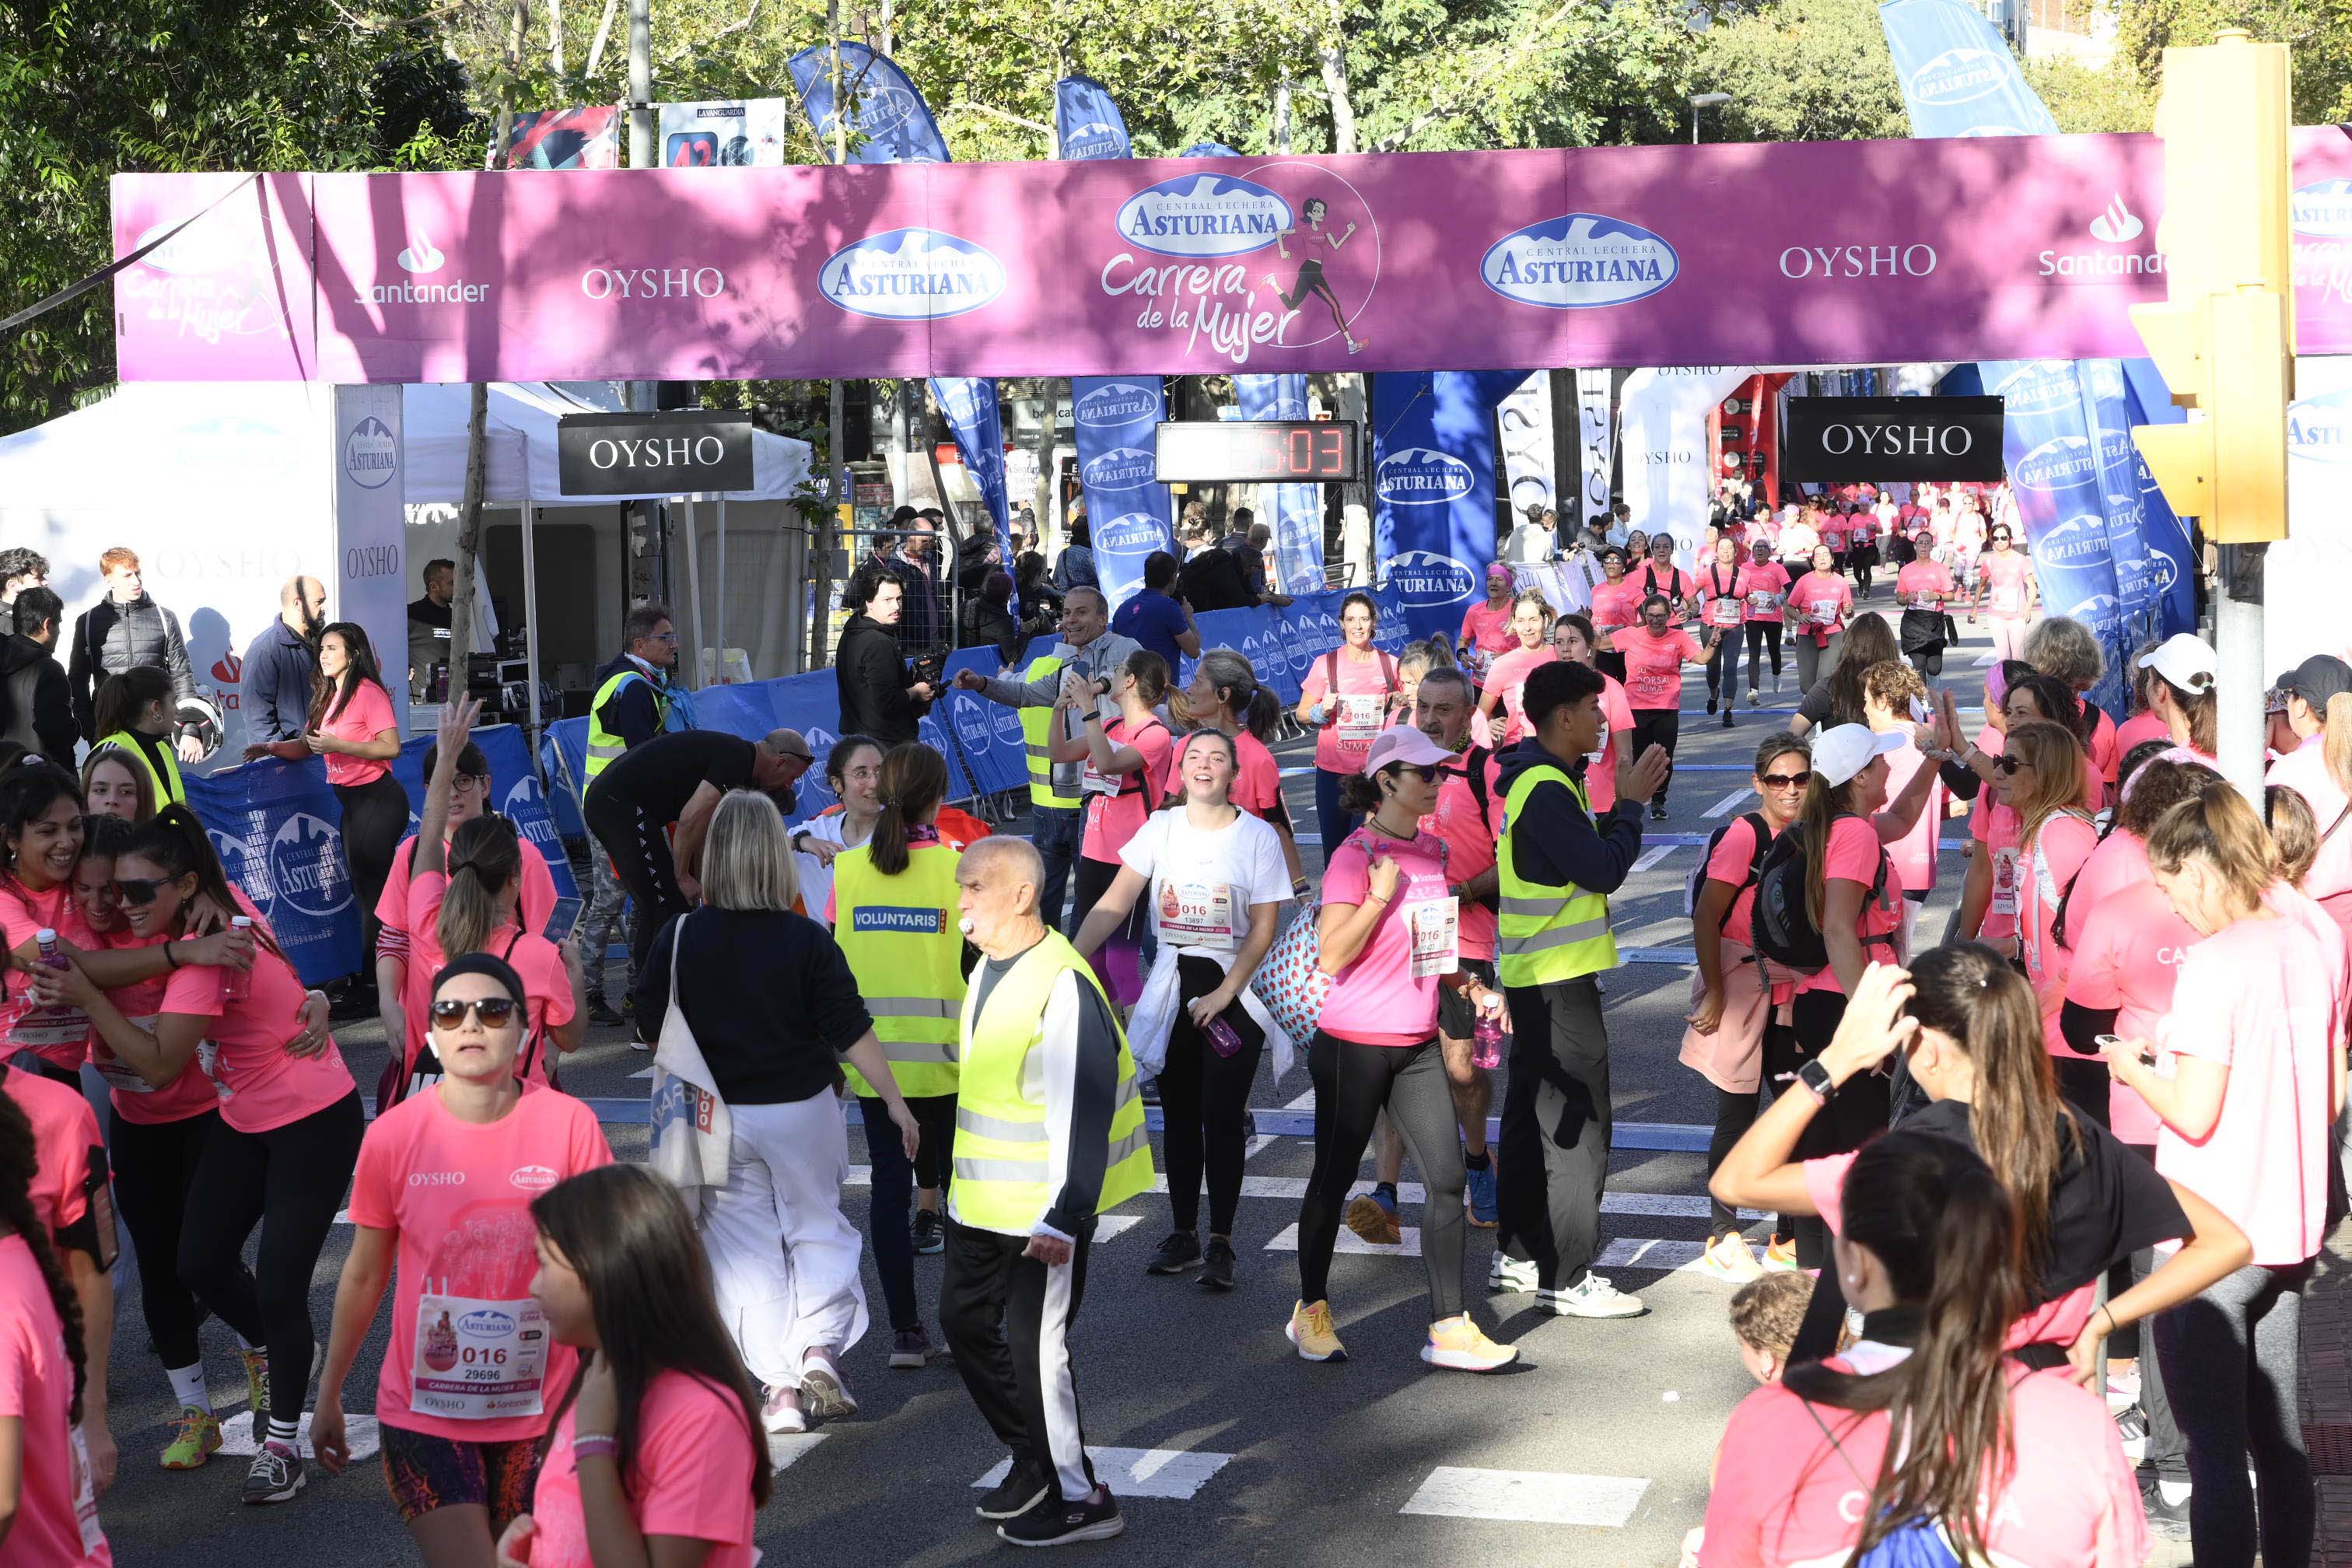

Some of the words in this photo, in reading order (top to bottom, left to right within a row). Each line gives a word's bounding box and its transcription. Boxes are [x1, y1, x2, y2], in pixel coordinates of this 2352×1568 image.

[1157, 201, 1213, 211] CENTRAL
[1218, 200, 1274, 210] LECHERA
[1129, 205, 1279, 236] ASTURIANA
[1526, 247, 1587, 257] CENTRAL
[1594, 245, 1657, 254] LECHERA
[1496, 250, 1664, 285] ASTURIANA
[1780, 244, 1937, 278] OYSHO
[2039, 249, 2169, 277] Santand
[581, 267, 725, 299] OYSHO
[832, 262, 990, 296] ASTURIANA
[1101, 253, 1247, 296] Carrera
[354, 278, 490, 304] Santander
[1136, 299, 1164, 328] de
[1170, 296, 1189, 328] la
[1185, 290, 1301, 364] Mujer
[1822, 424, 1972, 456] OYSHO
[348, 443, 394, 471] ASTURIANA
[590, 436, 724, 469] OYSHO
[1379, 471, 1467, 493] ASTURIANA
[347, 544, 398, 579] OYSHO
[1395, 577, 1468, 593] TURIANA
[1337, 739, 1371, 751] SUMA
[513, 813, 557, 843] ASTUR
[1181, 905, 1206, 915] 016
[855, 912, 936, 927] VOLUNTARIS
[1420, 929, 1439, 942] 016
[2157, 946, 2185, 964] CA
[408, 1171, 466, 1187] OYSHO
[514, 1173, 556, 1185] ASTURIANA
[461, 1320, 513, 1332] ASTURIANA
[462, 1347, 508, 1365] 016
[465, 1369, 501, 1381] 29696
[429, 1381, 466, 1391] CARRERA
[425, 1396, 466, 1410] OYSHO
[495, 1398, 533, 1409] Santander
